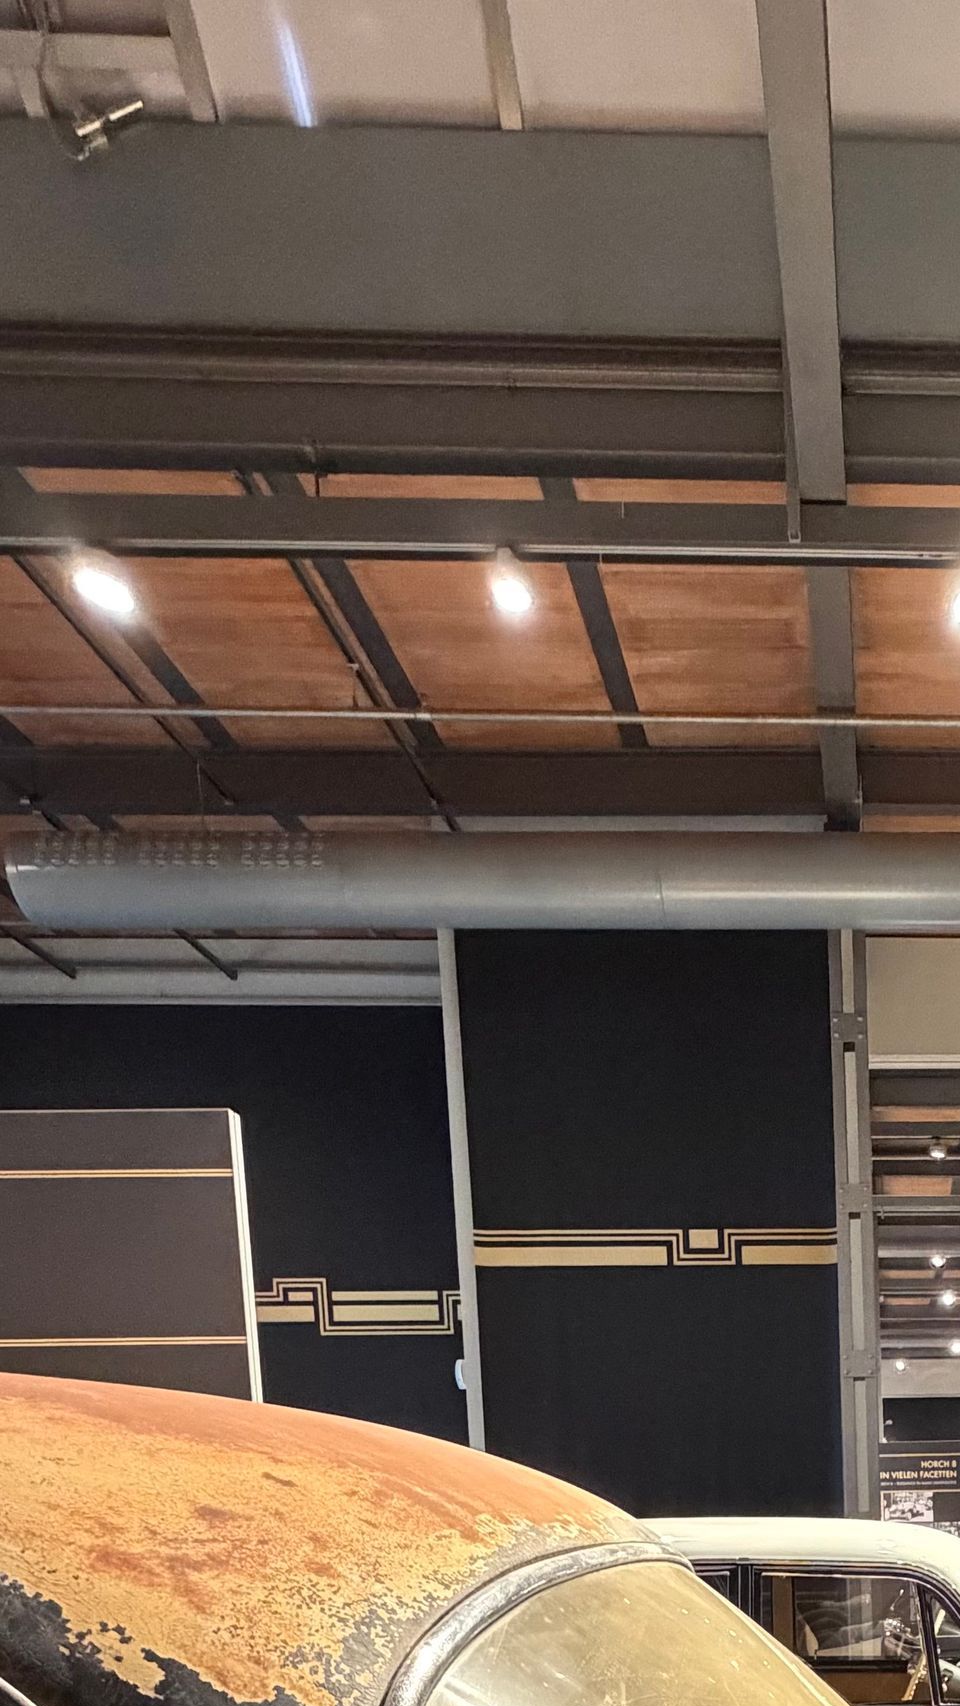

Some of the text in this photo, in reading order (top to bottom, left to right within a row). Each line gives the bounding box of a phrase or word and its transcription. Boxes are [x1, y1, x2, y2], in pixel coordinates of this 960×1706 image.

[920, 1459, 957, 1469] HORCH 8
[879, 1470, 957, 1480] IN VIELEN FACETTEN
